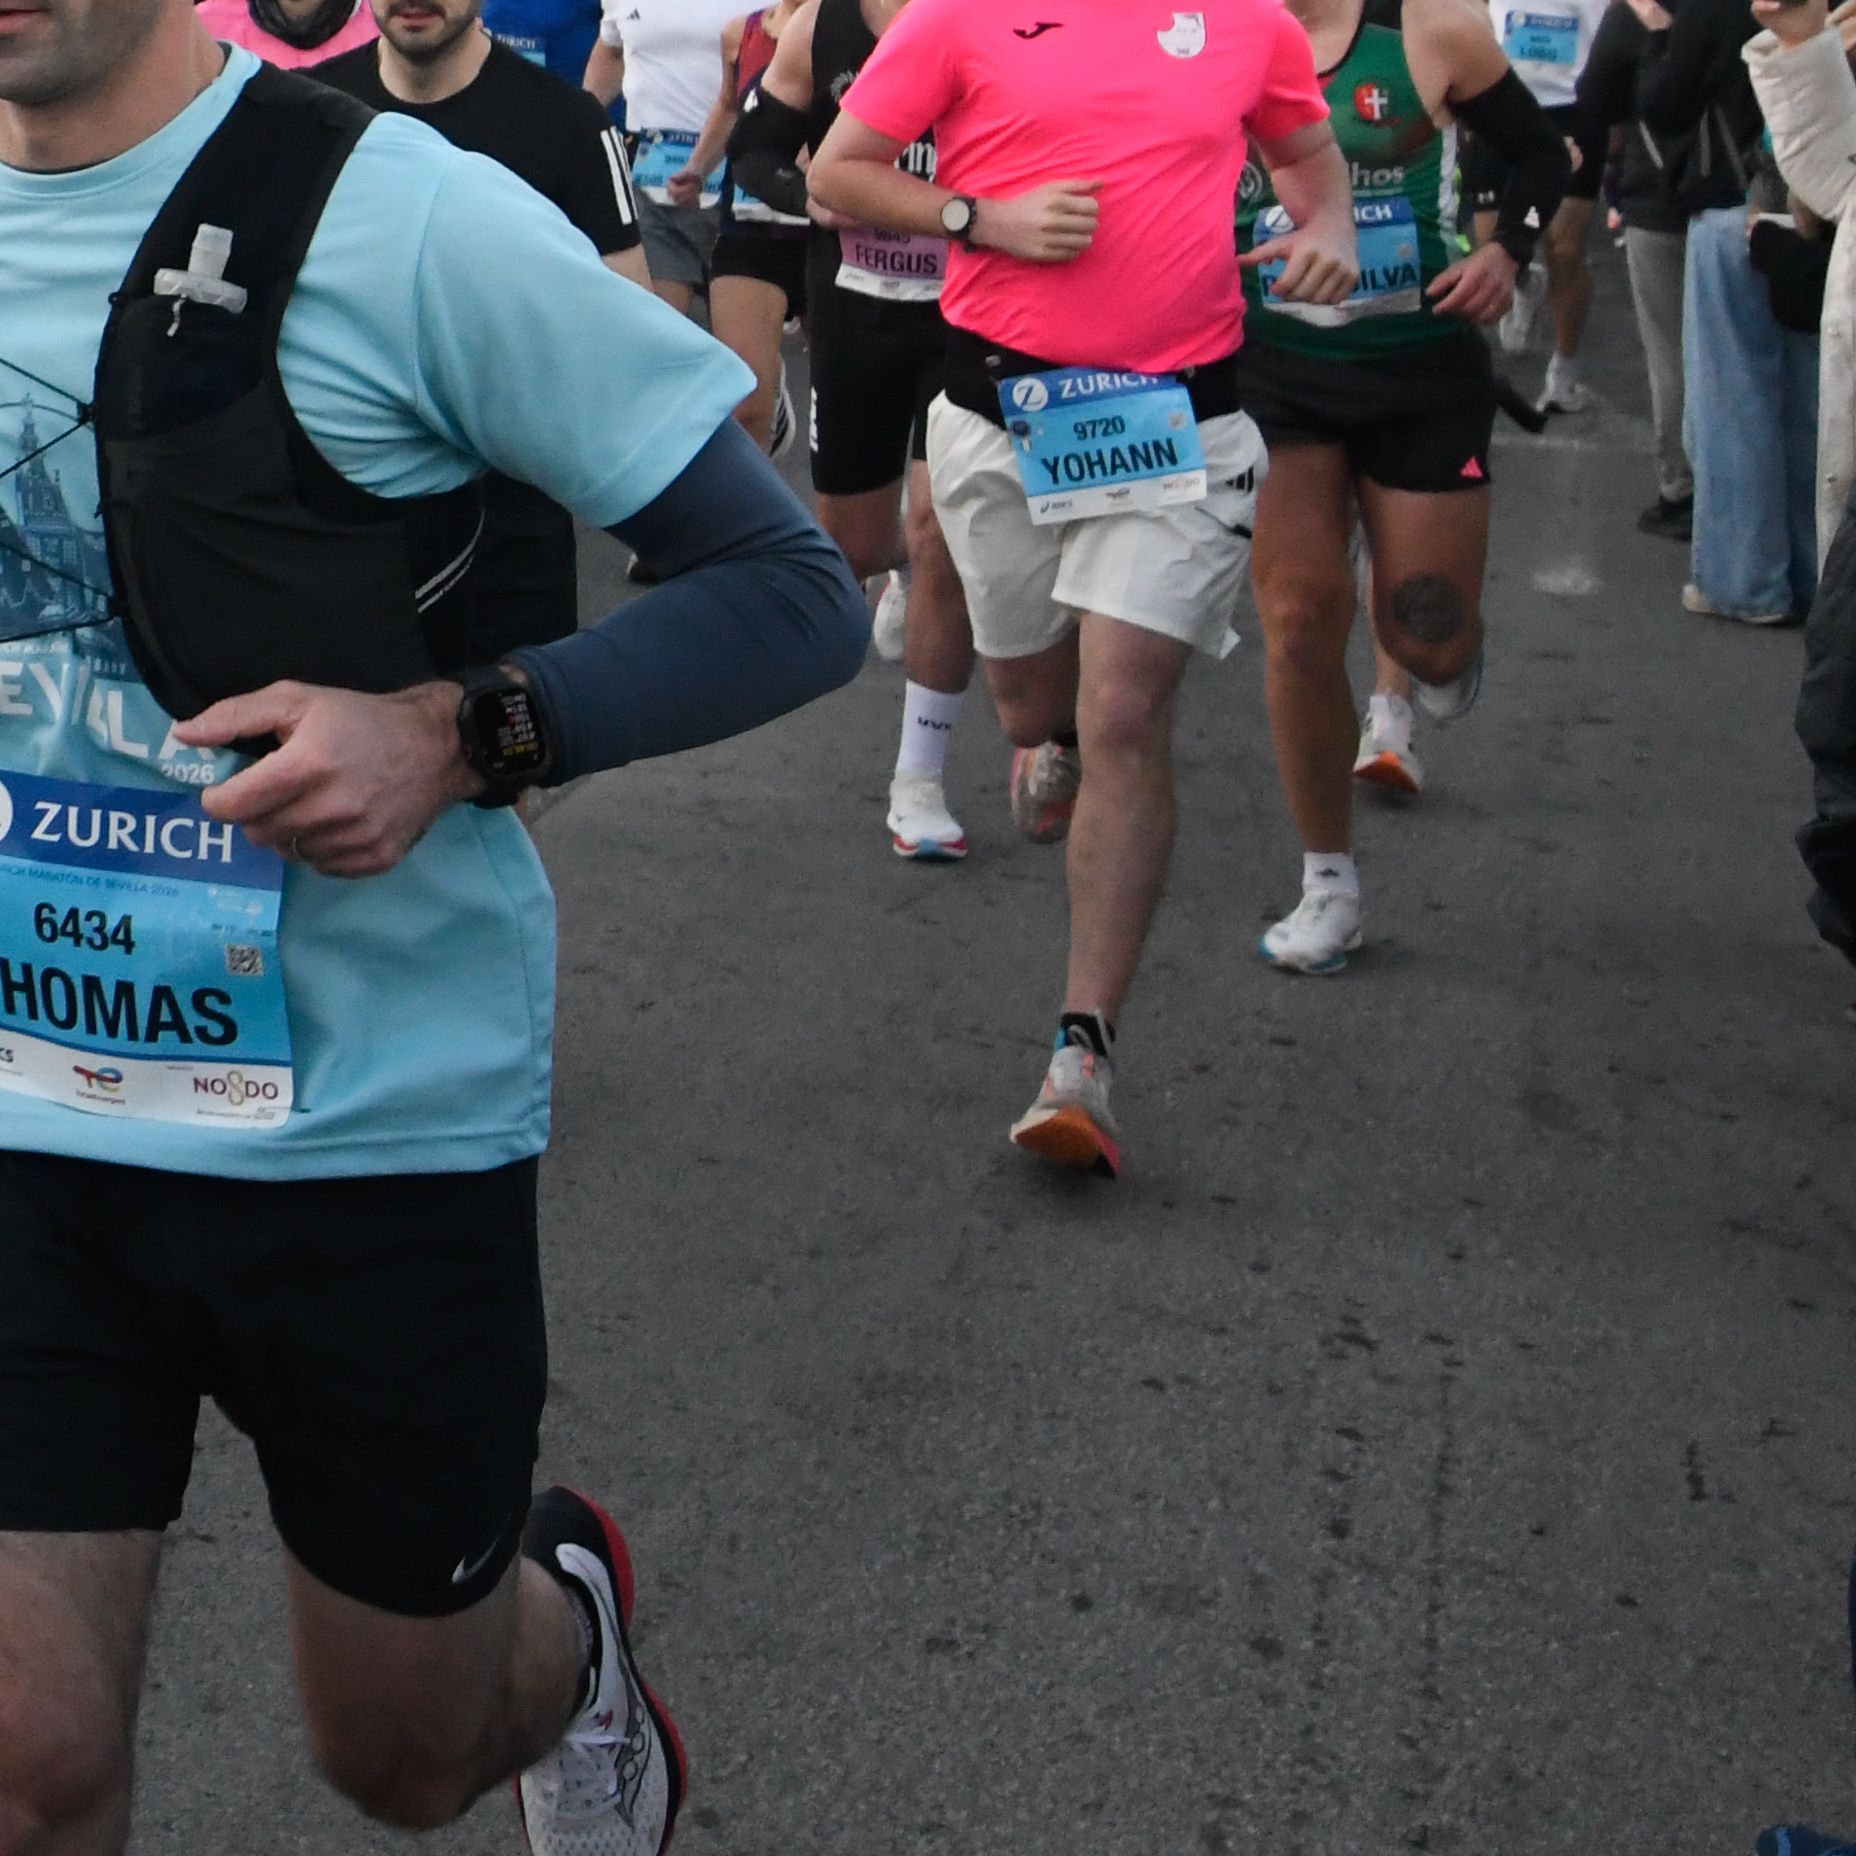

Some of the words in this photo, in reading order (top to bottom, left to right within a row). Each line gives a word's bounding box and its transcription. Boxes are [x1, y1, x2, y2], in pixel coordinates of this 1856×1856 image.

[856, 244, 938, 274] FERGUS
[1073, 415, 1126, 441] 9720
[1041, 438, 1178, 485] YOHANN
[161, 763, 216, 785] 2026
[30, 801, 234, 863] ZURICH
[34, 902, 136, 956] 6434
